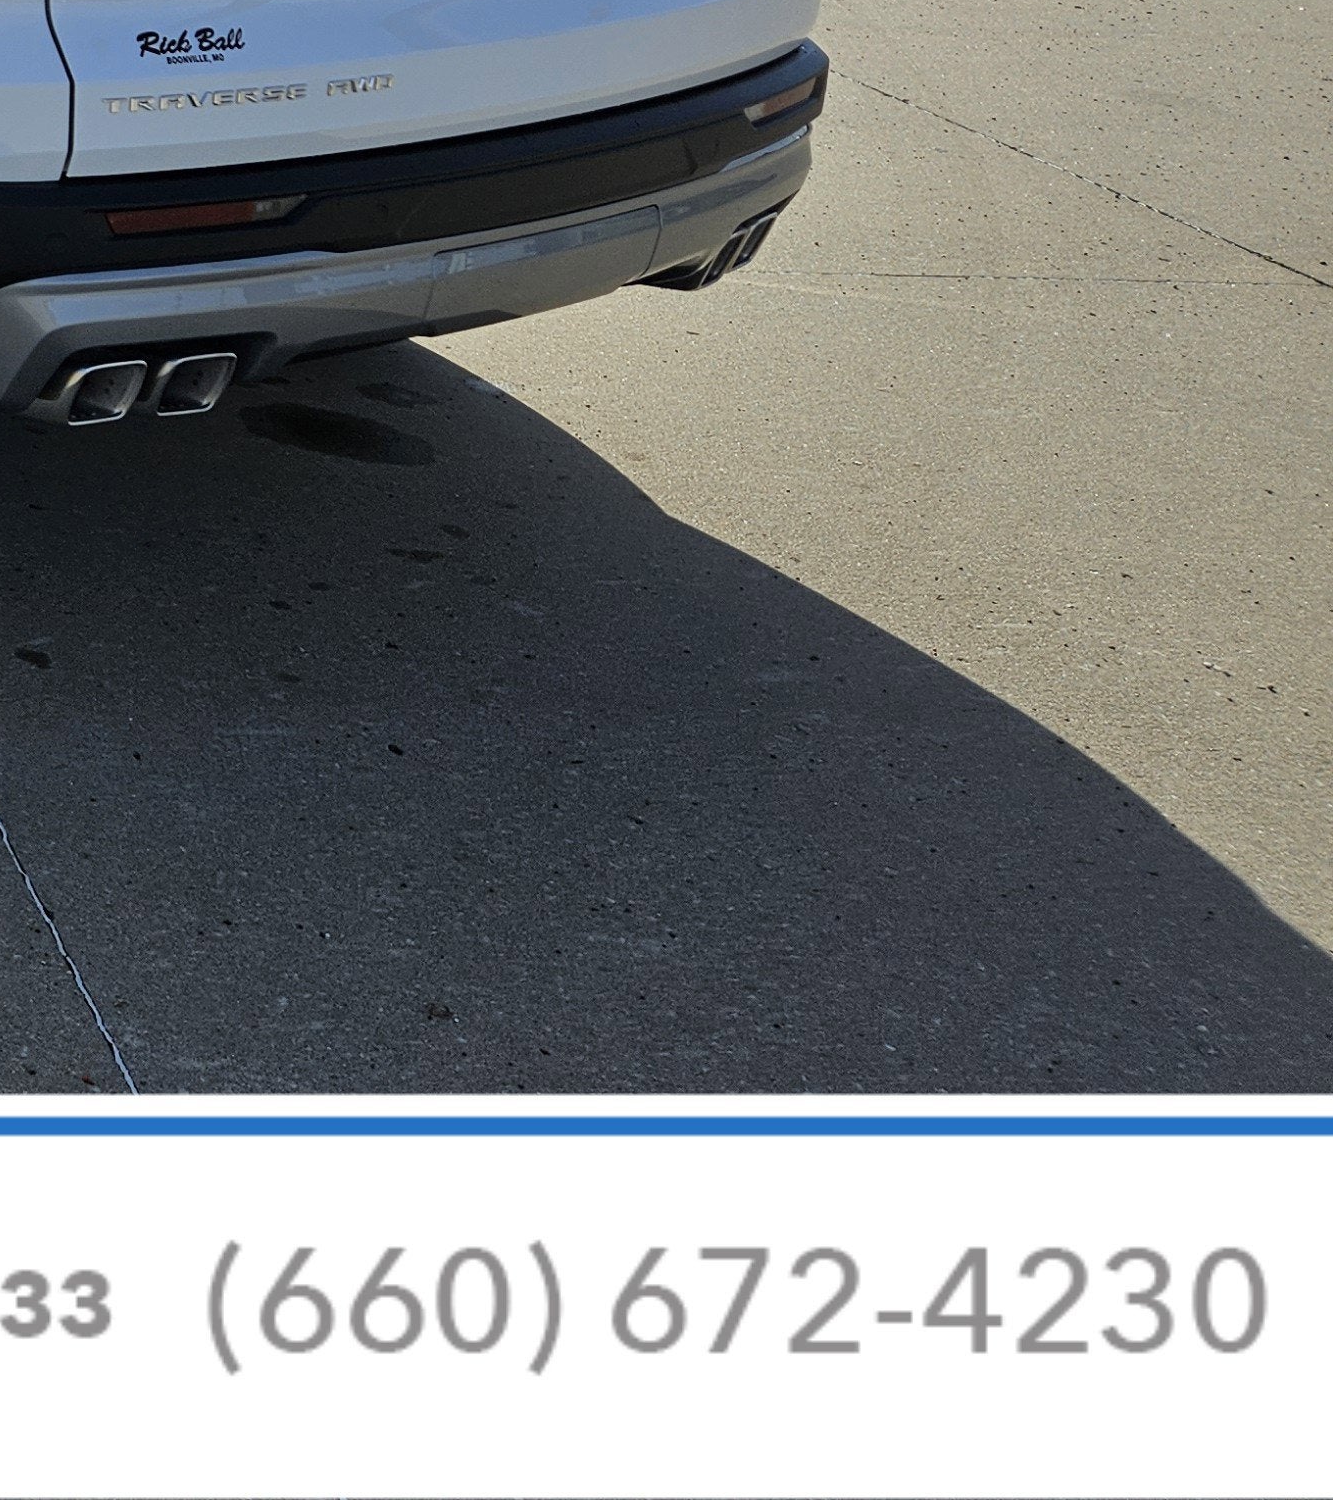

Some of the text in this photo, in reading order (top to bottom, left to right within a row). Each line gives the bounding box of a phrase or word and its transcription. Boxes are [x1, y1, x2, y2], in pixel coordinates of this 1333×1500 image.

[136, 27, 245, 57] Rick Ball
[166, 53, 225, 65] BOONVILLE, MO
[102, 72, 395, 114] TRAVERSE AWD
